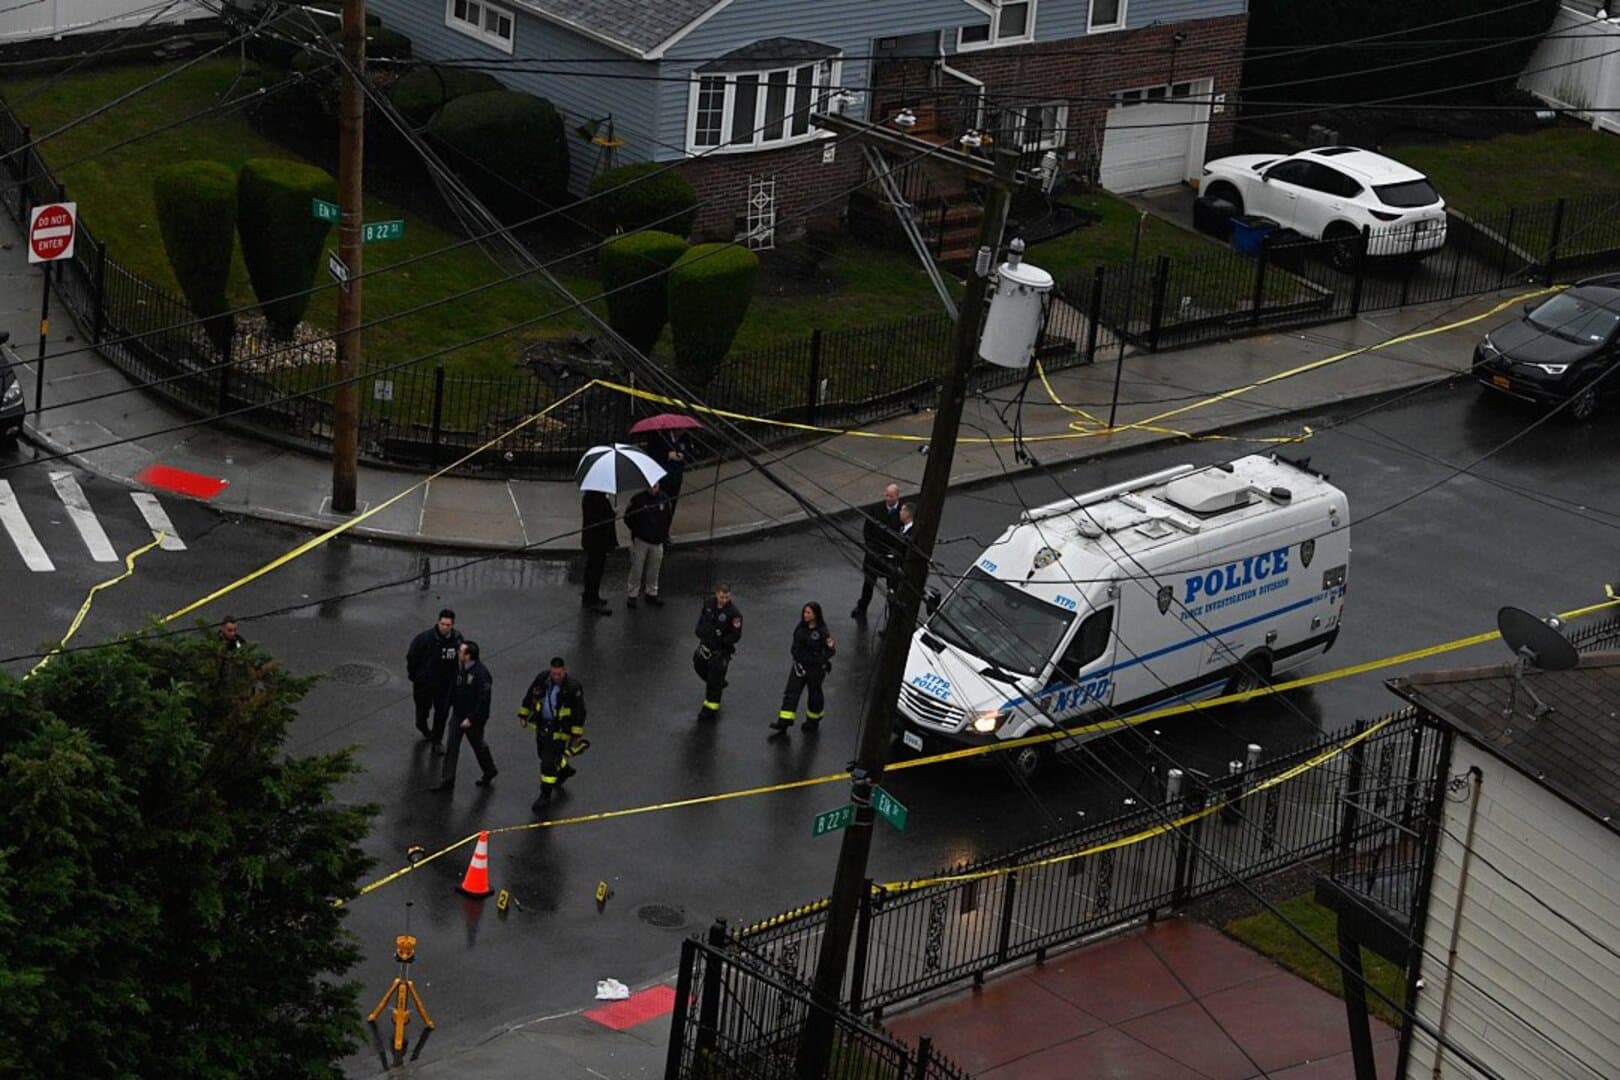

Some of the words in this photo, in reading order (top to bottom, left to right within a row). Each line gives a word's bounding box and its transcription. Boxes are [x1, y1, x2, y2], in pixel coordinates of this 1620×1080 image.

[38, 217, 49, 227] DO
[51, 214, 68, 225] NOT
[367, 226, 373, 240] B
[376, 224, 389, 239] 22
[38, 238, 64, 251] ENTER
[980, 559, 998, 573] NYPD
[1184, 545, 1290, 605] POLICE
[1054, 594, 1077, 610] NYPD
[1205, 588, 1258, 614] INVESTIGATION
[1259, 577, 1290, 596] DIVISION
[911, 677, 952, 700] POLICE
[923, 672, 951, 690] NYPD
[1052, 678, 1111, 714] NYPD
[817, 816, 825, 834] B
[827, 811, 840, 830] 22
[499, 893, 506, 907] 2
